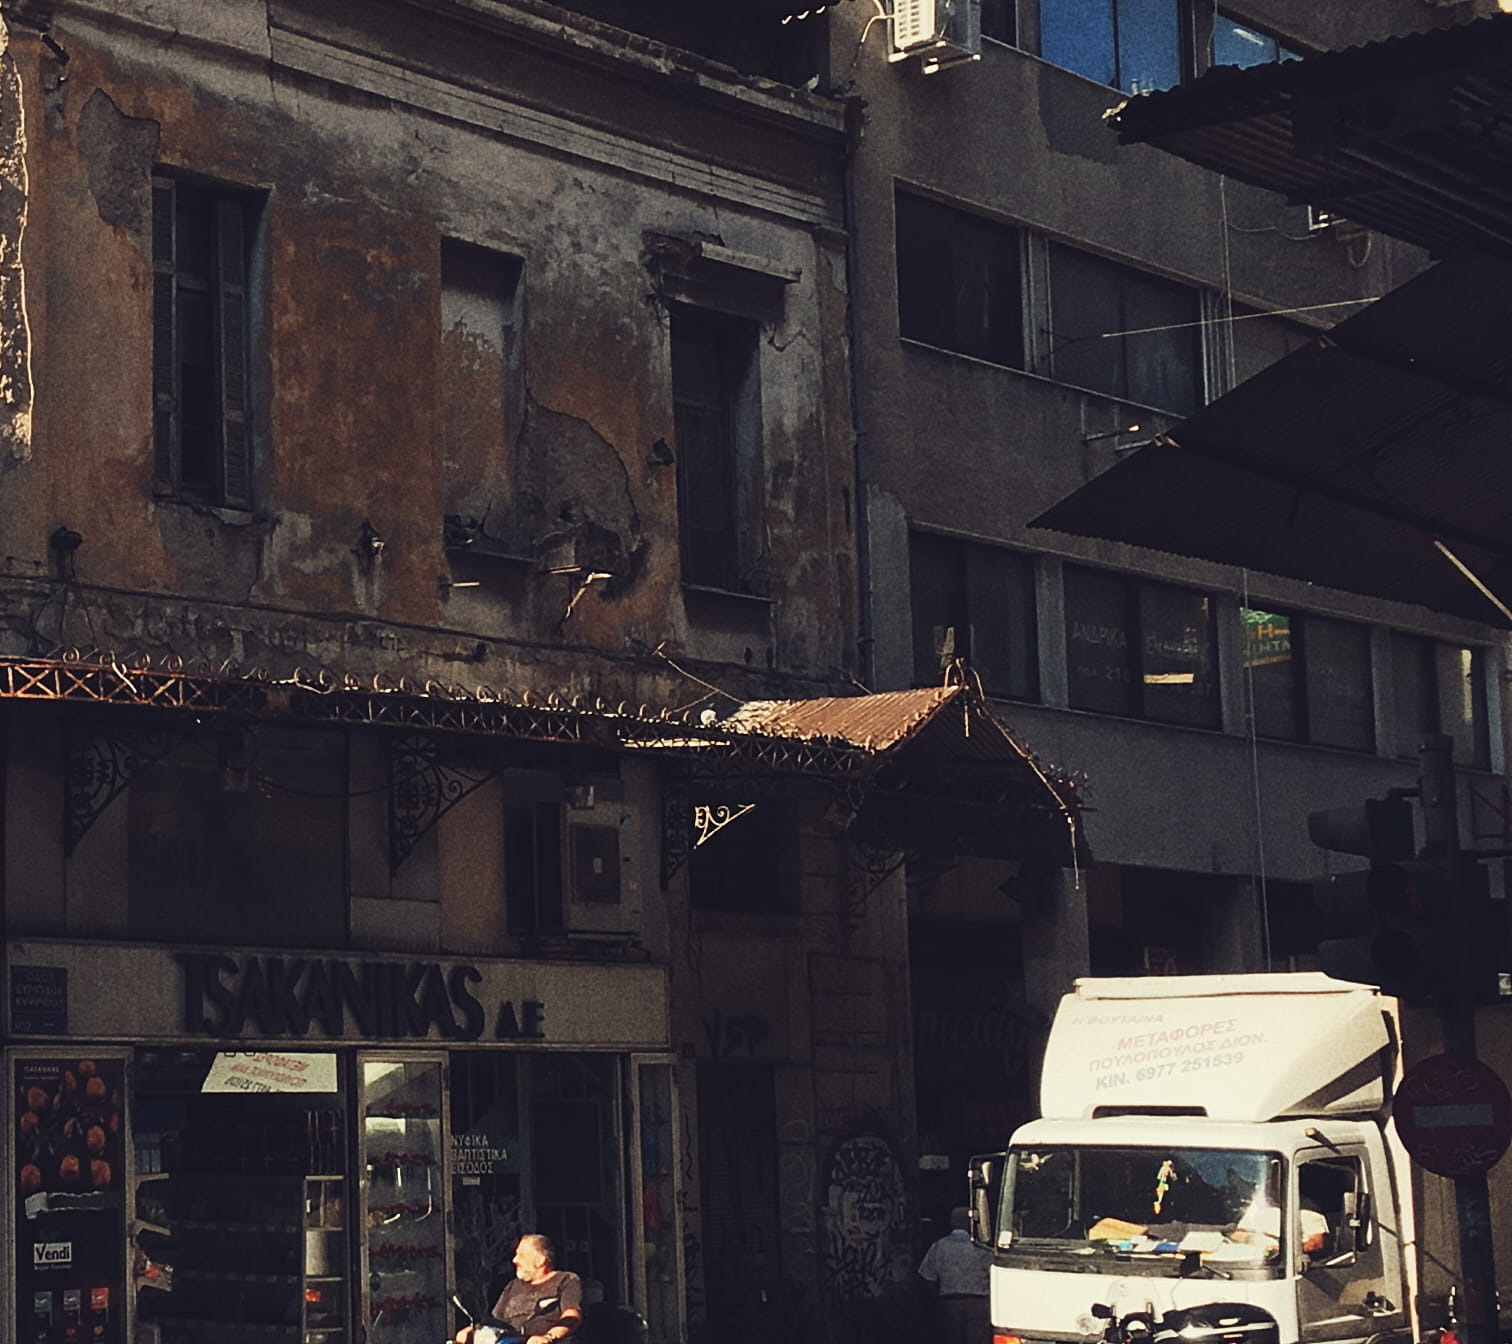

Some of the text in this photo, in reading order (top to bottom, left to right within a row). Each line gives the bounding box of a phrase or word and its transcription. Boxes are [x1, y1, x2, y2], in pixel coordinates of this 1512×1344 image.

[177, 953, 485, 1041] TSAKANIKAS
[1117, 1019, 1239, 1050] ΜΕΤΑΦΟΡΕΣ
[1088, 1040, 1218, 1073] ΠΟΥΛΟΠΟΥΛΟΣ
[1135, 1062, 1178, 1082] 6977
[1181, 1052, 1245, 1073] 251539
[35, 1245, 71, 1263] Vendi
